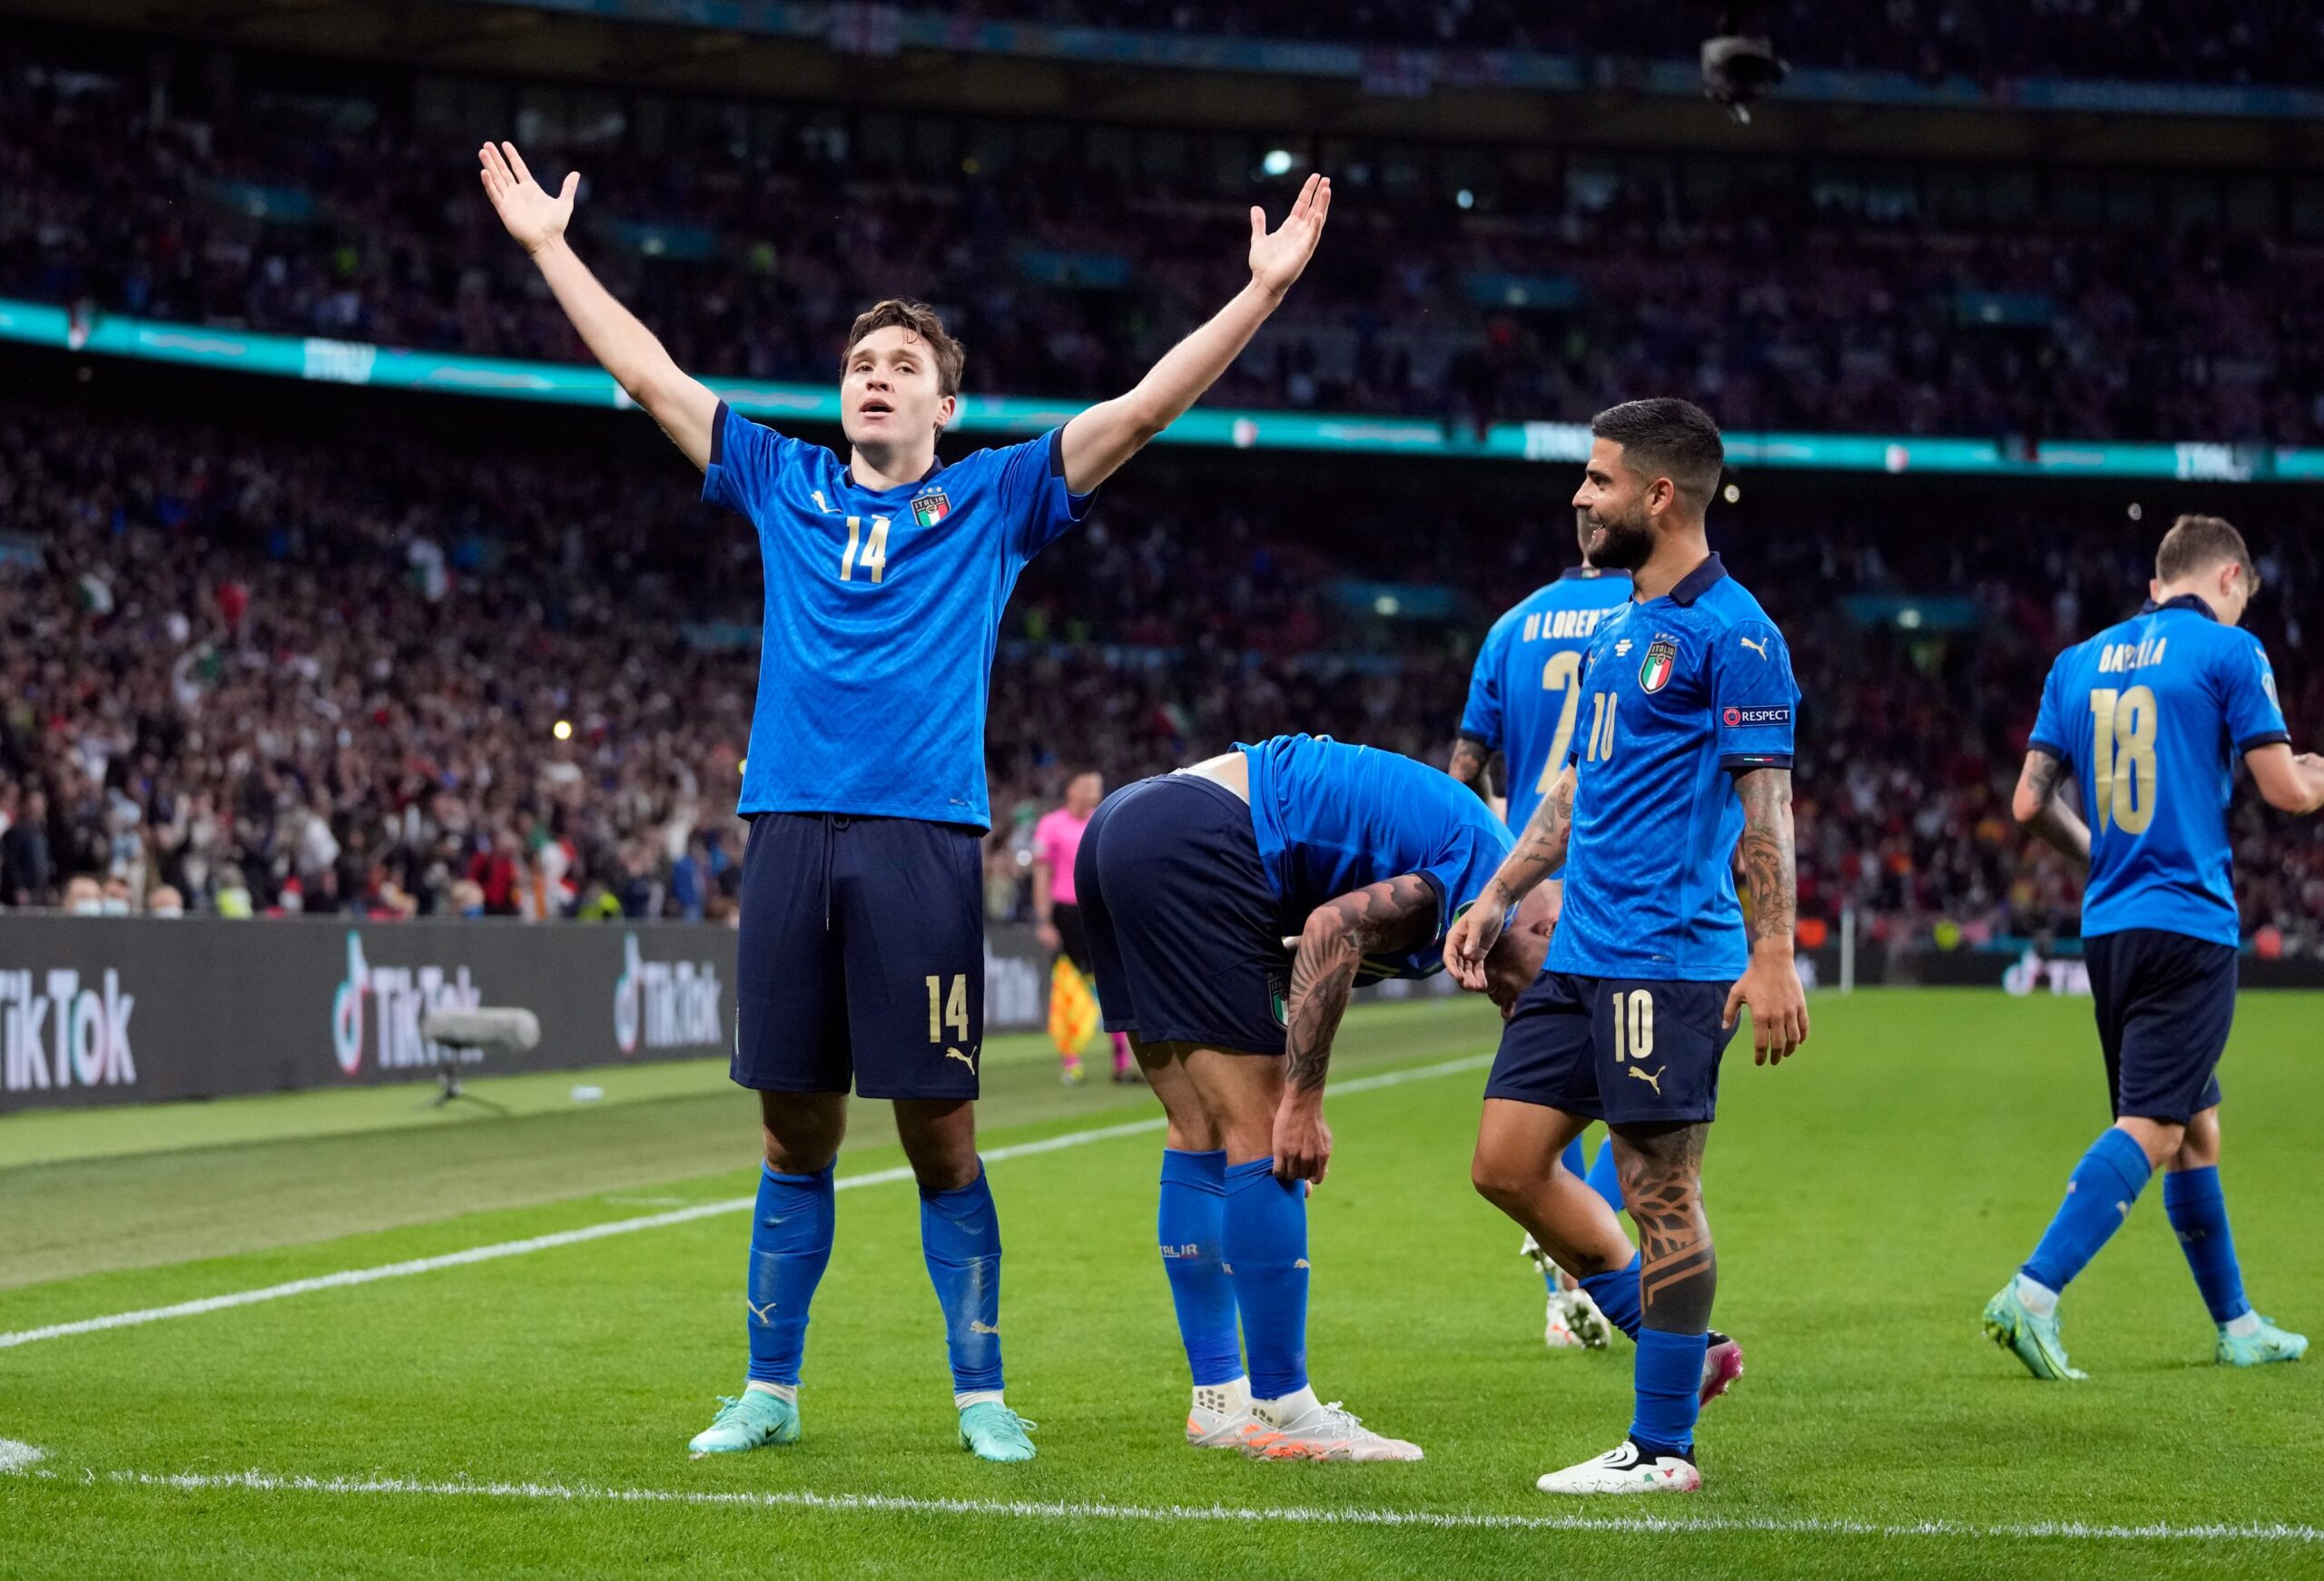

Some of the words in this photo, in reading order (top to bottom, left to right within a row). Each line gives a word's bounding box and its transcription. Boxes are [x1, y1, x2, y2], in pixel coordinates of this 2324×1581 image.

[914, 496, 944, 509] ITALIA
[840, 514, 891, 584] 14
[1541, 608, 1610, 639] LOREN
[1651, 644, 1674, 655] ITALIA
[1535, 650, 1582, 795] 2
[1586, 692, 1618, 761] 10
[1742, 710, 1790, 722] RESPECT
[2090, 684, 2158, 837] 18
[0, 967, 137, 1091] ikTok
[925, 973, 969, 1044] 14
[1612, 988, 1654, 1063] 10
